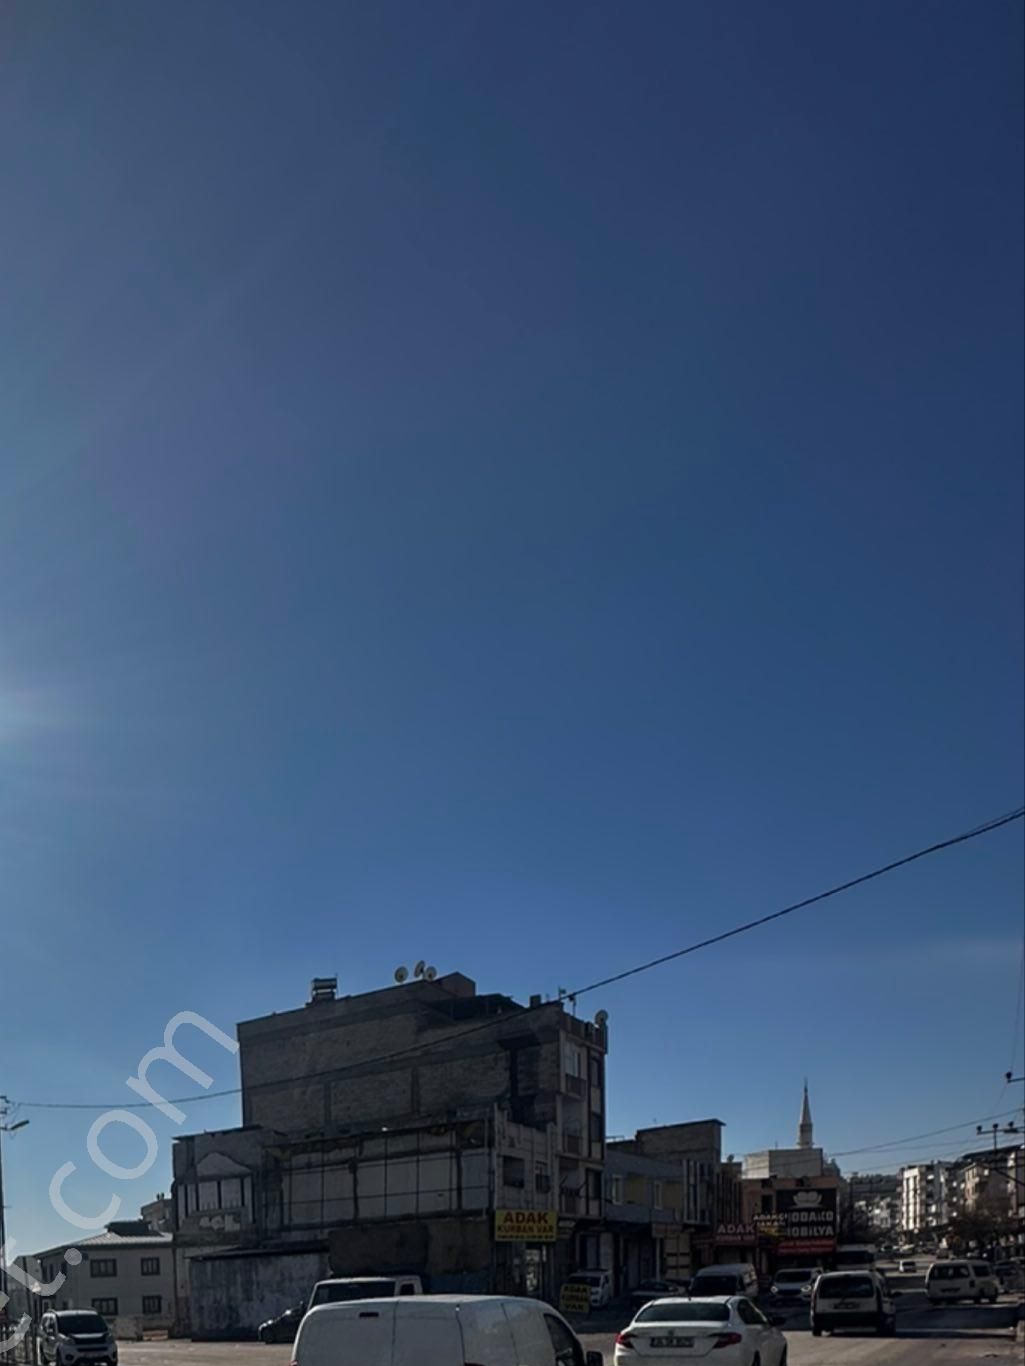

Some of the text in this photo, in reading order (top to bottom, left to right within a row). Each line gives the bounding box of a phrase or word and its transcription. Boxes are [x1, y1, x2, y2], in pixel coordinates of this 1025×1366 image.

[503, 1212, 548, 1225] ADAK
[786, 1210, 834, 1222] ODAKO
[537, 1225, 554, 1233] VAR
[717, 1223, 755, 1234] ADAK
[786, 1225, 835, 1237] OBİLYA
